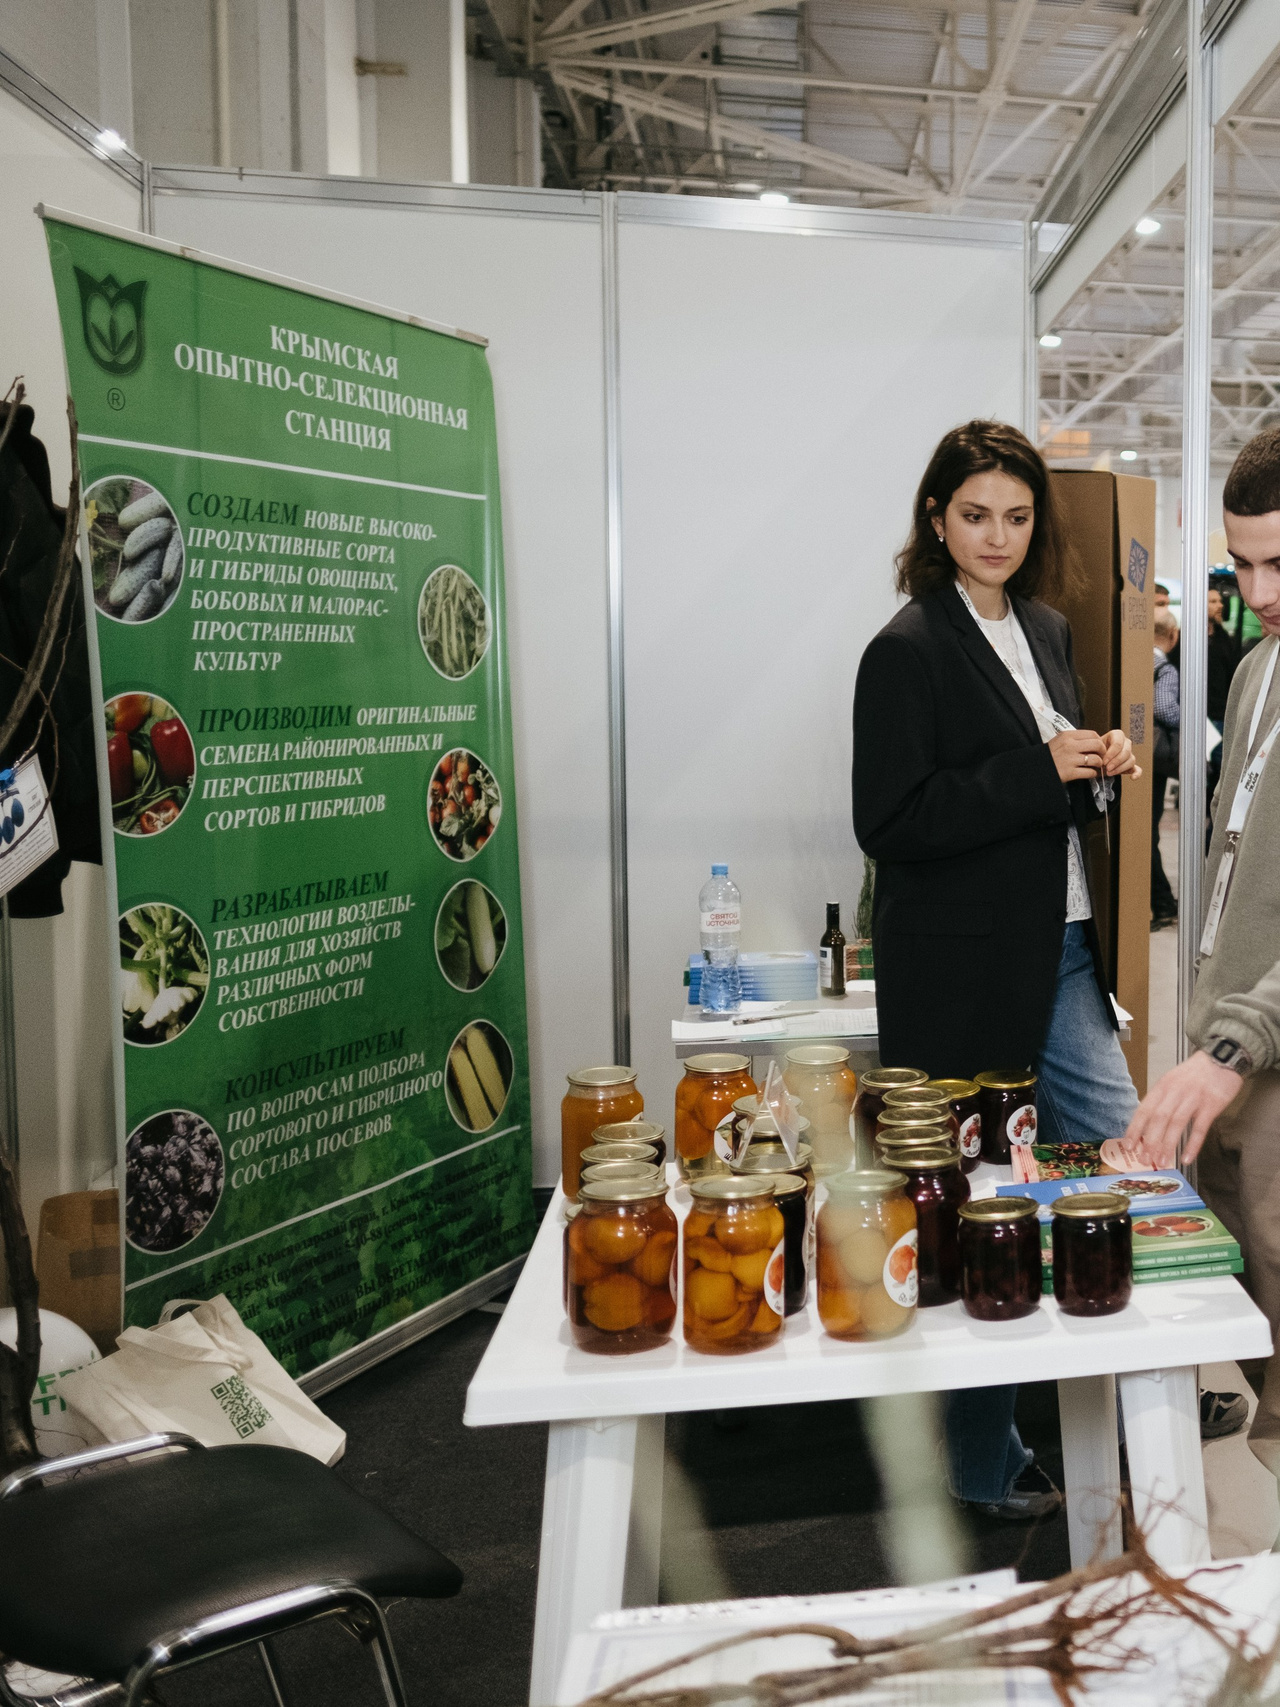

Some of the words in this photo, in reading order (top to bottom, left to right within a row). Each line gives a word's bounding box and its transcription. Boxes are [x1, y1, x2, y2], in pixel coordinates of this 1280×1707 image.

[270, 325, 399, 379] КРЫМСКАЯ
[174, 343, 468, 431] ОПЫТНО-СЕЛЕКЦИОННАЯ
[285, 410, 392, 451] СТАНЦИЯ
[187, 492, 299, 527] СОЗДАЕМ
[303, 510, 364, 535] НОВЫЕ
[369, 517, 437, 541] ВЫСОКО-
[187, 528, 342, 560] ПРОДУКТИВНЫЕ
[346, 542, 396, 565] СОРТА
[189, 560, 204, 578] И
[209, 560, 303, 584] ГИБРИДЫ
[307, 569, 398, 593] ОВОЩНЫХ,
[191, 590, 286, 613] БОБОВЫХ
[291, 595, 303, 613] И
[308, 597, 389, 618] МАЛОРАС-
[193, 620, 355, 644] ПРОСТРАНЕННЫХ
[194, 650, 281, 671] КУЛЬТУР
[198, 705, 351, 733] ПРОИЗВОДИМ
[357, 705, 476, 726] ОРИГИНАЛЬНЫЕ
[200, 742, 279, 766] СЕМЕНА
[282, 733, 430, 761] РАЙОНИРОВАННЫХ
[431, 733, 443, 750] И
[201, 768, 363, 799] ПЕРСПЕКТИВНЫХ
[205, 806, 280, 832] СОРТОВ
[284, 803, 297, 822] И
[301, 795, 385, 823] ГИБРИДОВ
[210, 870, 389, 923] РАЗРАБАТЫВАЕМ
[213, 911, 333, 950] ТЕХНОЛОГИИ
[337, 894, 415, 926] ВОЗДЕЛЫ-
[215, 948, 279, 979] ВАНИЯ
[284, 938, 316, 964] ДЛЯ
[320, 921, 401, 952] ХОЗЯЙСТВ
[217, 967, 322, 1006] РАЗЛИЧНЫХ
[325, 950, 372, 980] ФОРМ
[219, 978, 364, 1033] СОБСТВЕННОСТИ
[224, 1027, 405, 1105] КОНСУЛЬТИРУЕМ
[227, 1109, 255, 1133] ПО
[260, 1076, 354, 1124] ВОПРОСАМ
[358, 1051, 425, 1089] ПОДБОРА
[230, 1113, 327, 1161] СОРТОВОГО
[333, 1105, 345, 1123] И
[349, 1069, 443, 1118] ГИБРИДНОГО
[231, 1148, 312, 1191] СОСТАВА
[316, 1114, 392, 1157] ПОСЕВОВ
[278, 1289, 391, 1363] РАНТИРОВАННЫЙ
